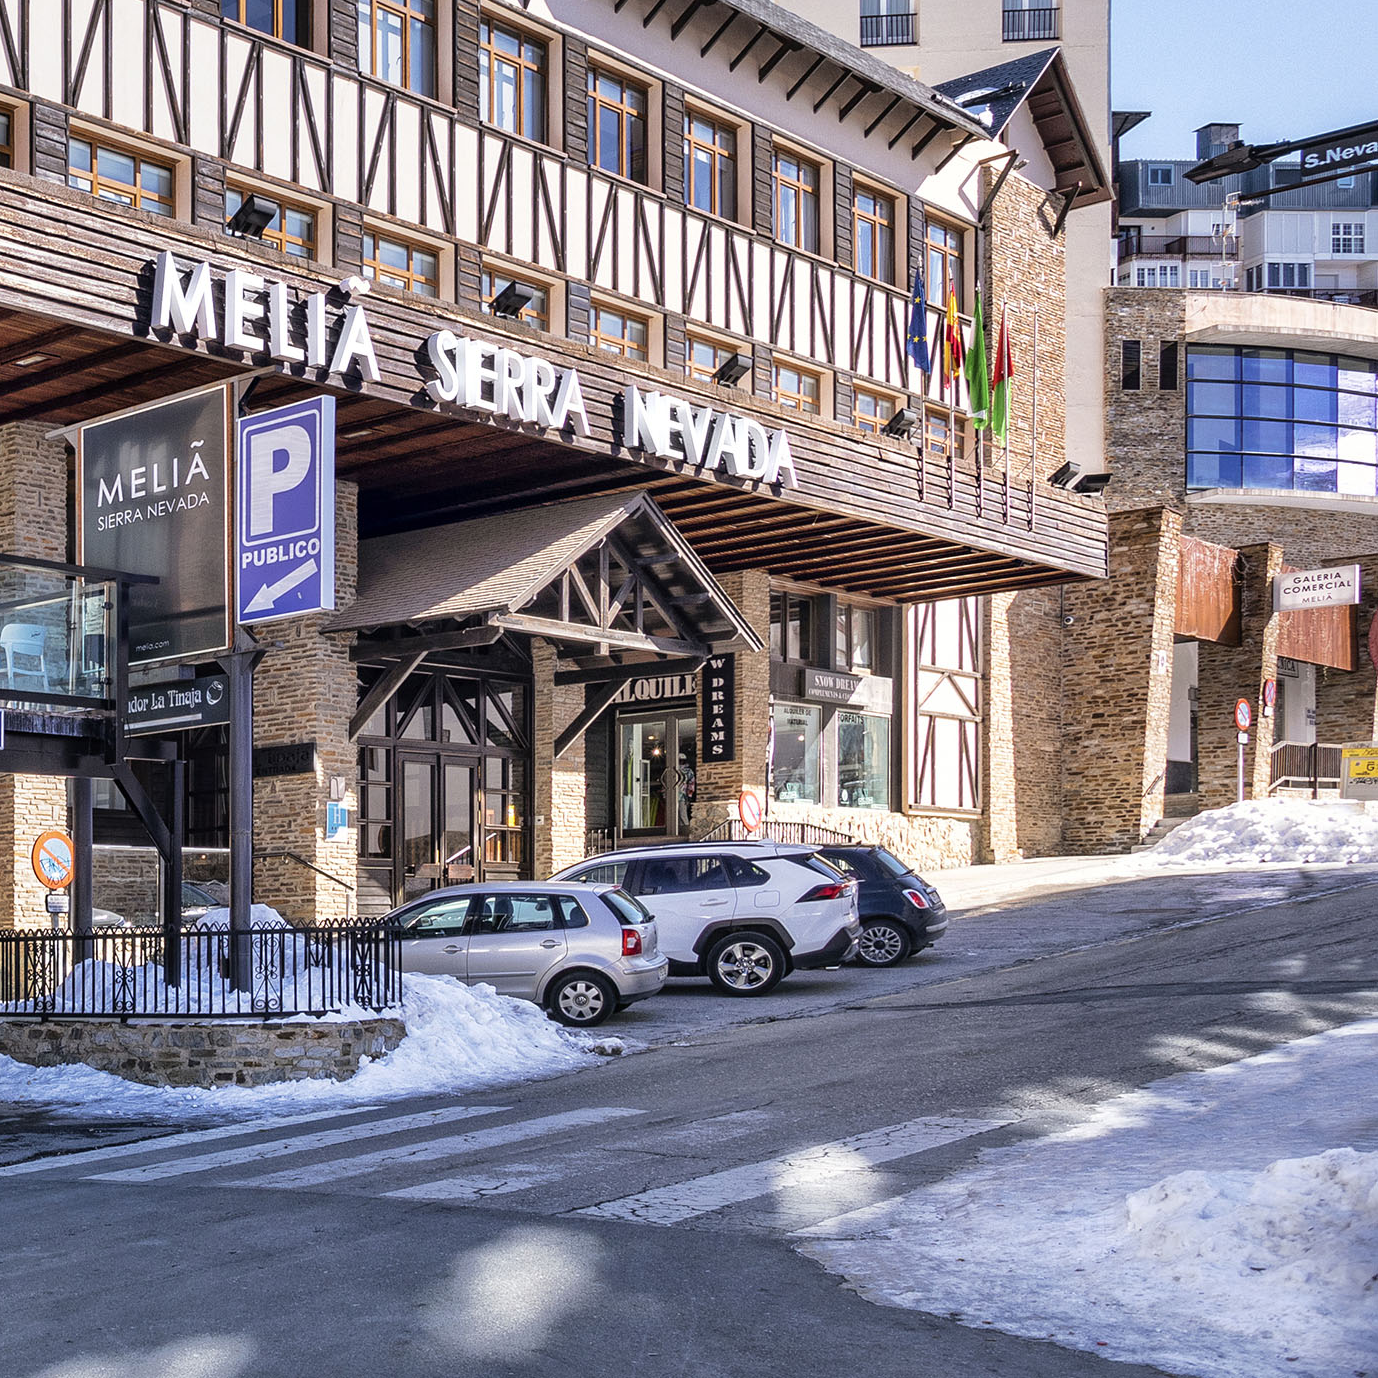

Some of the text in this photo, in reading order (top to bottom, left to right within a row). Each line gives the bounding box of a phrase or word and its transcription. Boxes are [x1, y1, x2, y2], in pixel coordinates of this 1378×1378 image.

[425, 329, 591, 437] SIERRA
[624, 384, 798, 490] NEVADA
[250, 425, 312, 537] P
[97, 491, 210, 532] SIERRA NEVADA
[242, 538, 320, 569] PUBLICO
[1283, 580, 1352, 595] COMERCIAL
[1293, 572, 1341, 584] GALERIA
[135, 639, 170, 652] melia.com
[151, 692, 165, 709] La
[167, 688, 202, 709] Tinaja
[710, 677, 725, 755] DREAMS
[837, 713, 865, 725] FORFAITS
